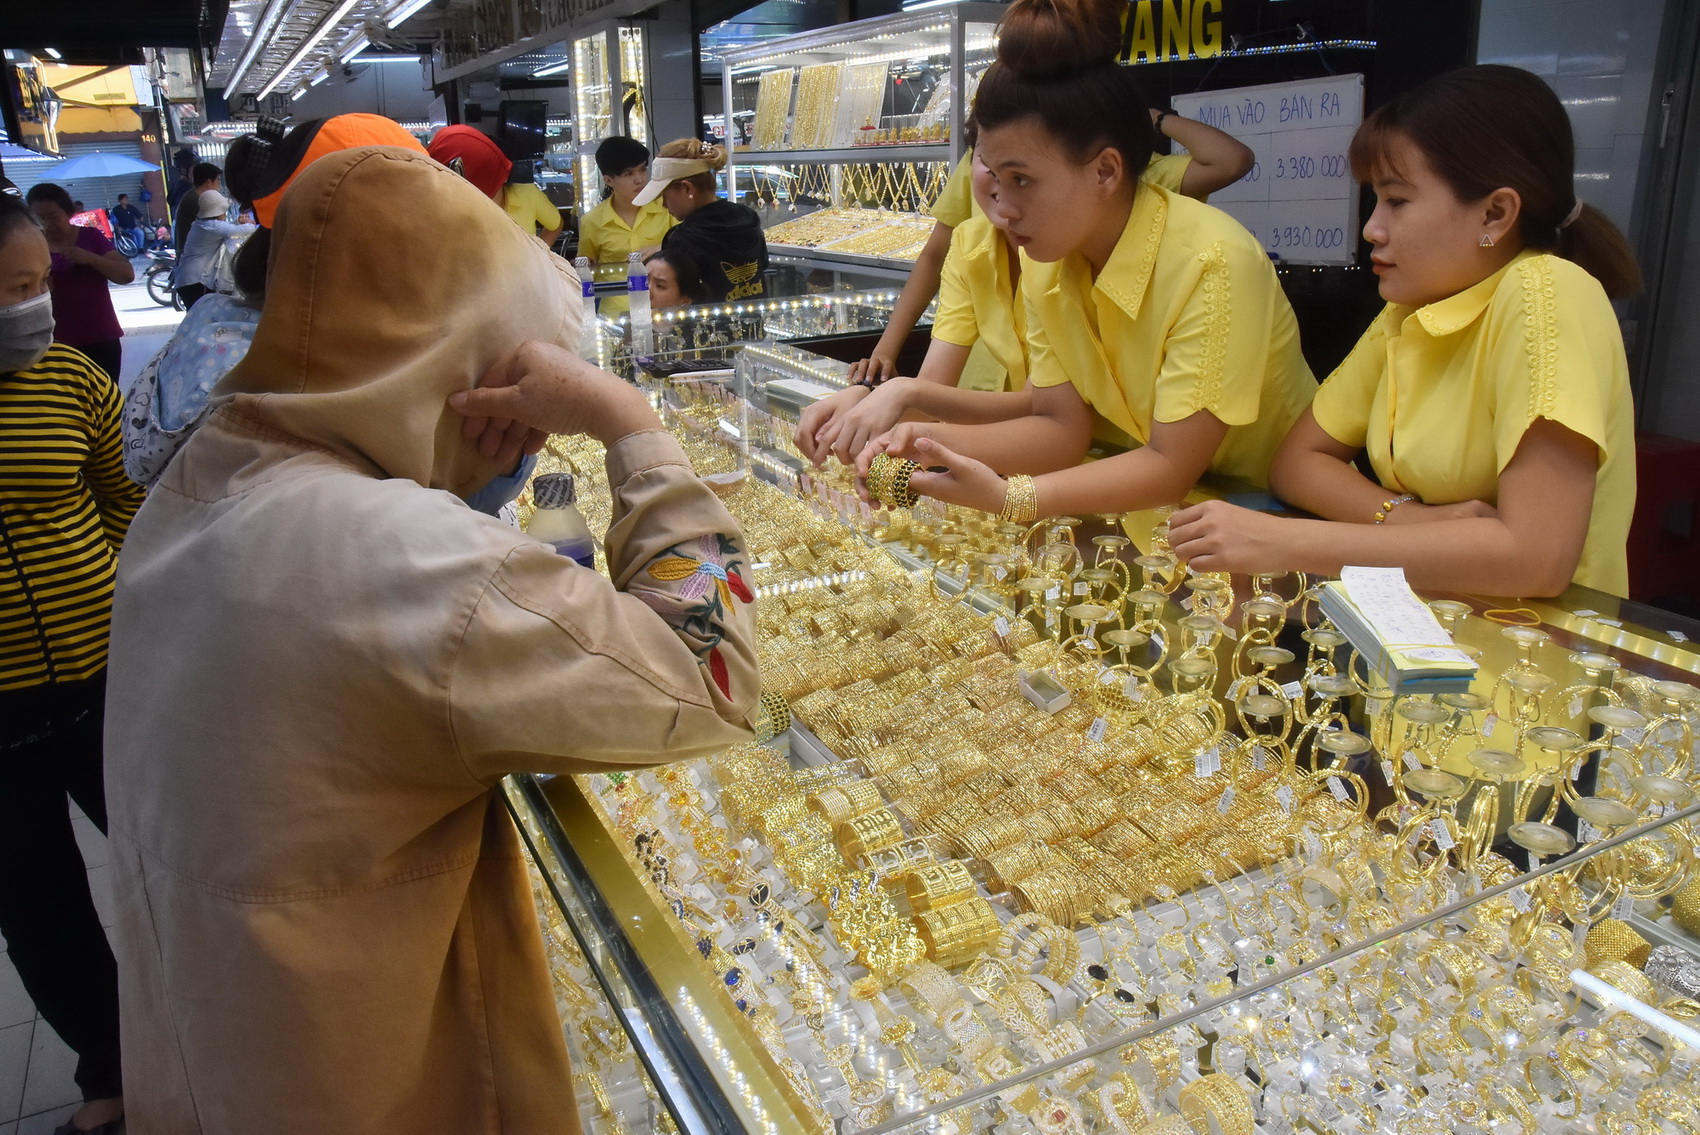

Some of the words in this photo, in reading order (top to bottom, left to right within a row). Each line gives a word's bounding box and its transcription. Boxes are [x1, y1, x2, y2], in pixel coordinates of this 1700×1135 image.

[1200, 104, 1231, 129] MUA
[1320, 92, 1341, 118] RA
[141, 134, 156, 143] 140
[725, 279, 764, 301] adidas
